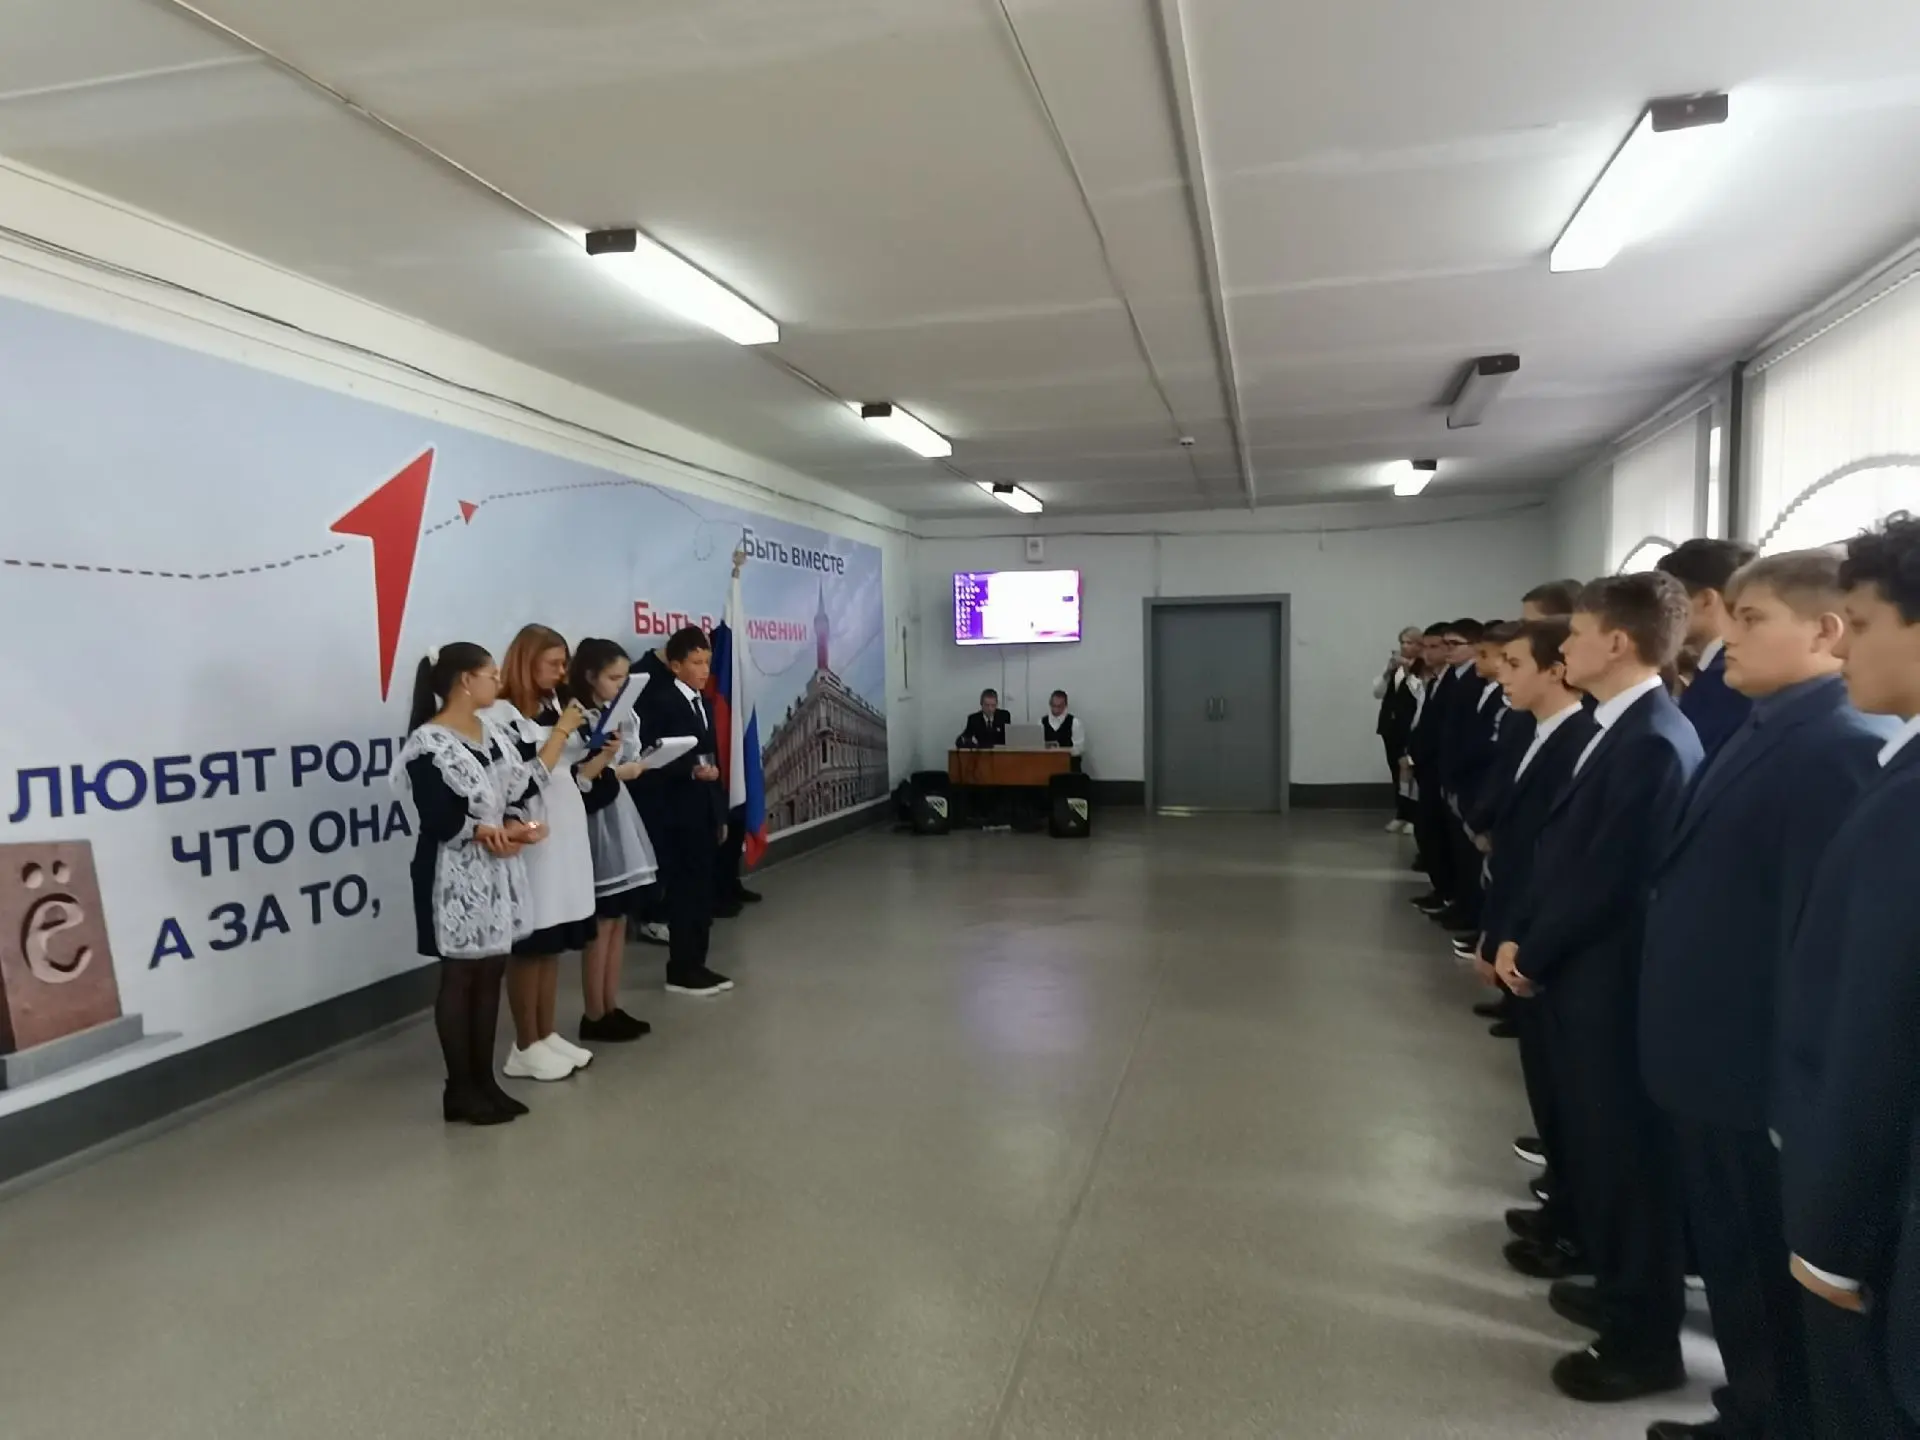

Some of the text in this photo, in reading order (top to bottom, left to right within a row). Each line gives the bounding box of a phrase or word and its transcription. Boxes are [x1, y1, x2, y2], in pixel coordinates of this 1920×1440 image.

[742, 527, 845, 575] Быть вместе
[8, 736, 407, 823] ЛЮБЯТ РОД
[171, 800, 412, 877] ЧТО ОНА
[147, 873, 381, 970] А ЗА ТО,
